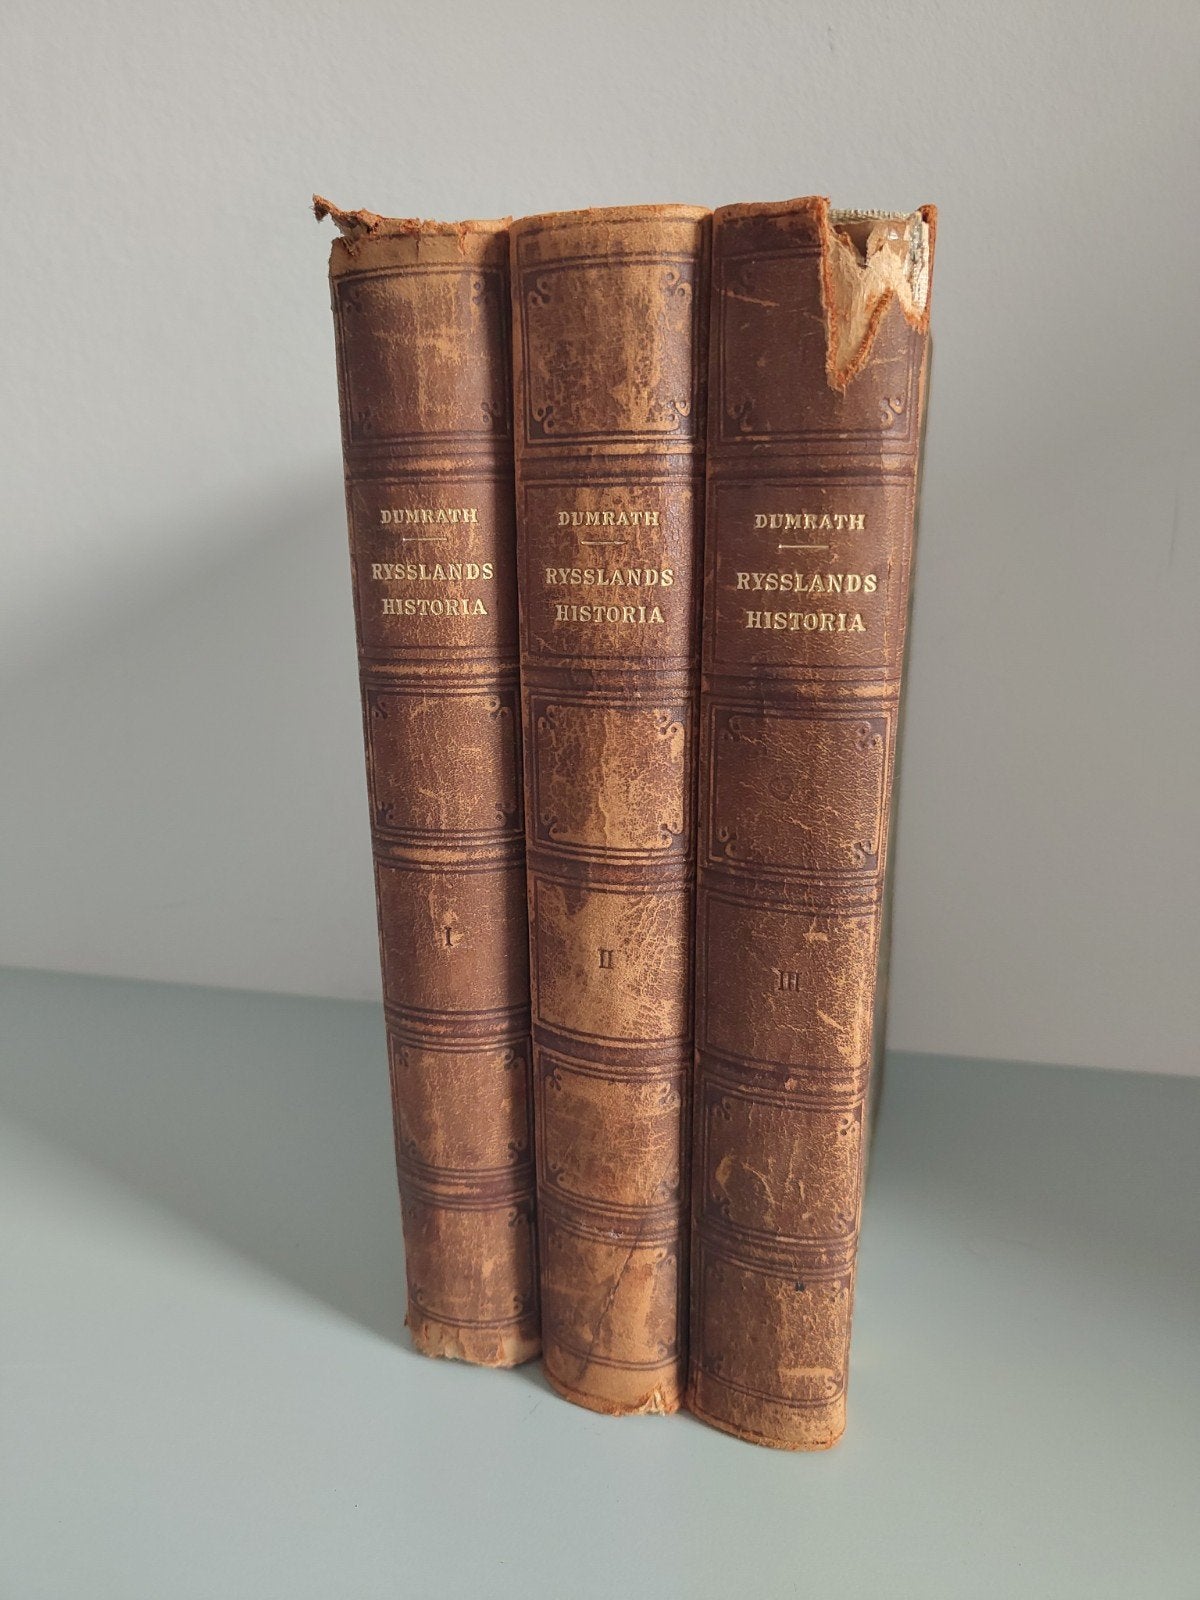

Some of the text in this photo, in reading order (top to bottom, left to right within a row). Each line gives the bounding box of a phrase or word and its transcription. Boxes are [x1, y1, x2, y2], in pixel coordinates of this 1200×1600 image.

[380, 508, 478, 524] DUMRATH
[558, 511, 660, 526] DUMRATH
[754, 513, 866, 530] DUMRATH
[371, 562, 494, 580] RYSSLANDS
[545, 567, 674, 587] RYSSLANDS
[736, 571, 878, 593] RYSSLANDS
[382, 598, 488, 616] HISTORIA
[555, 603, 665, 624] HISTORIA
[745, 610, 867, 632] HISTORIA
[444, 926, 453, 947] I
[598, 947, 614, 970] II
[778, 969, 802, 993] III
